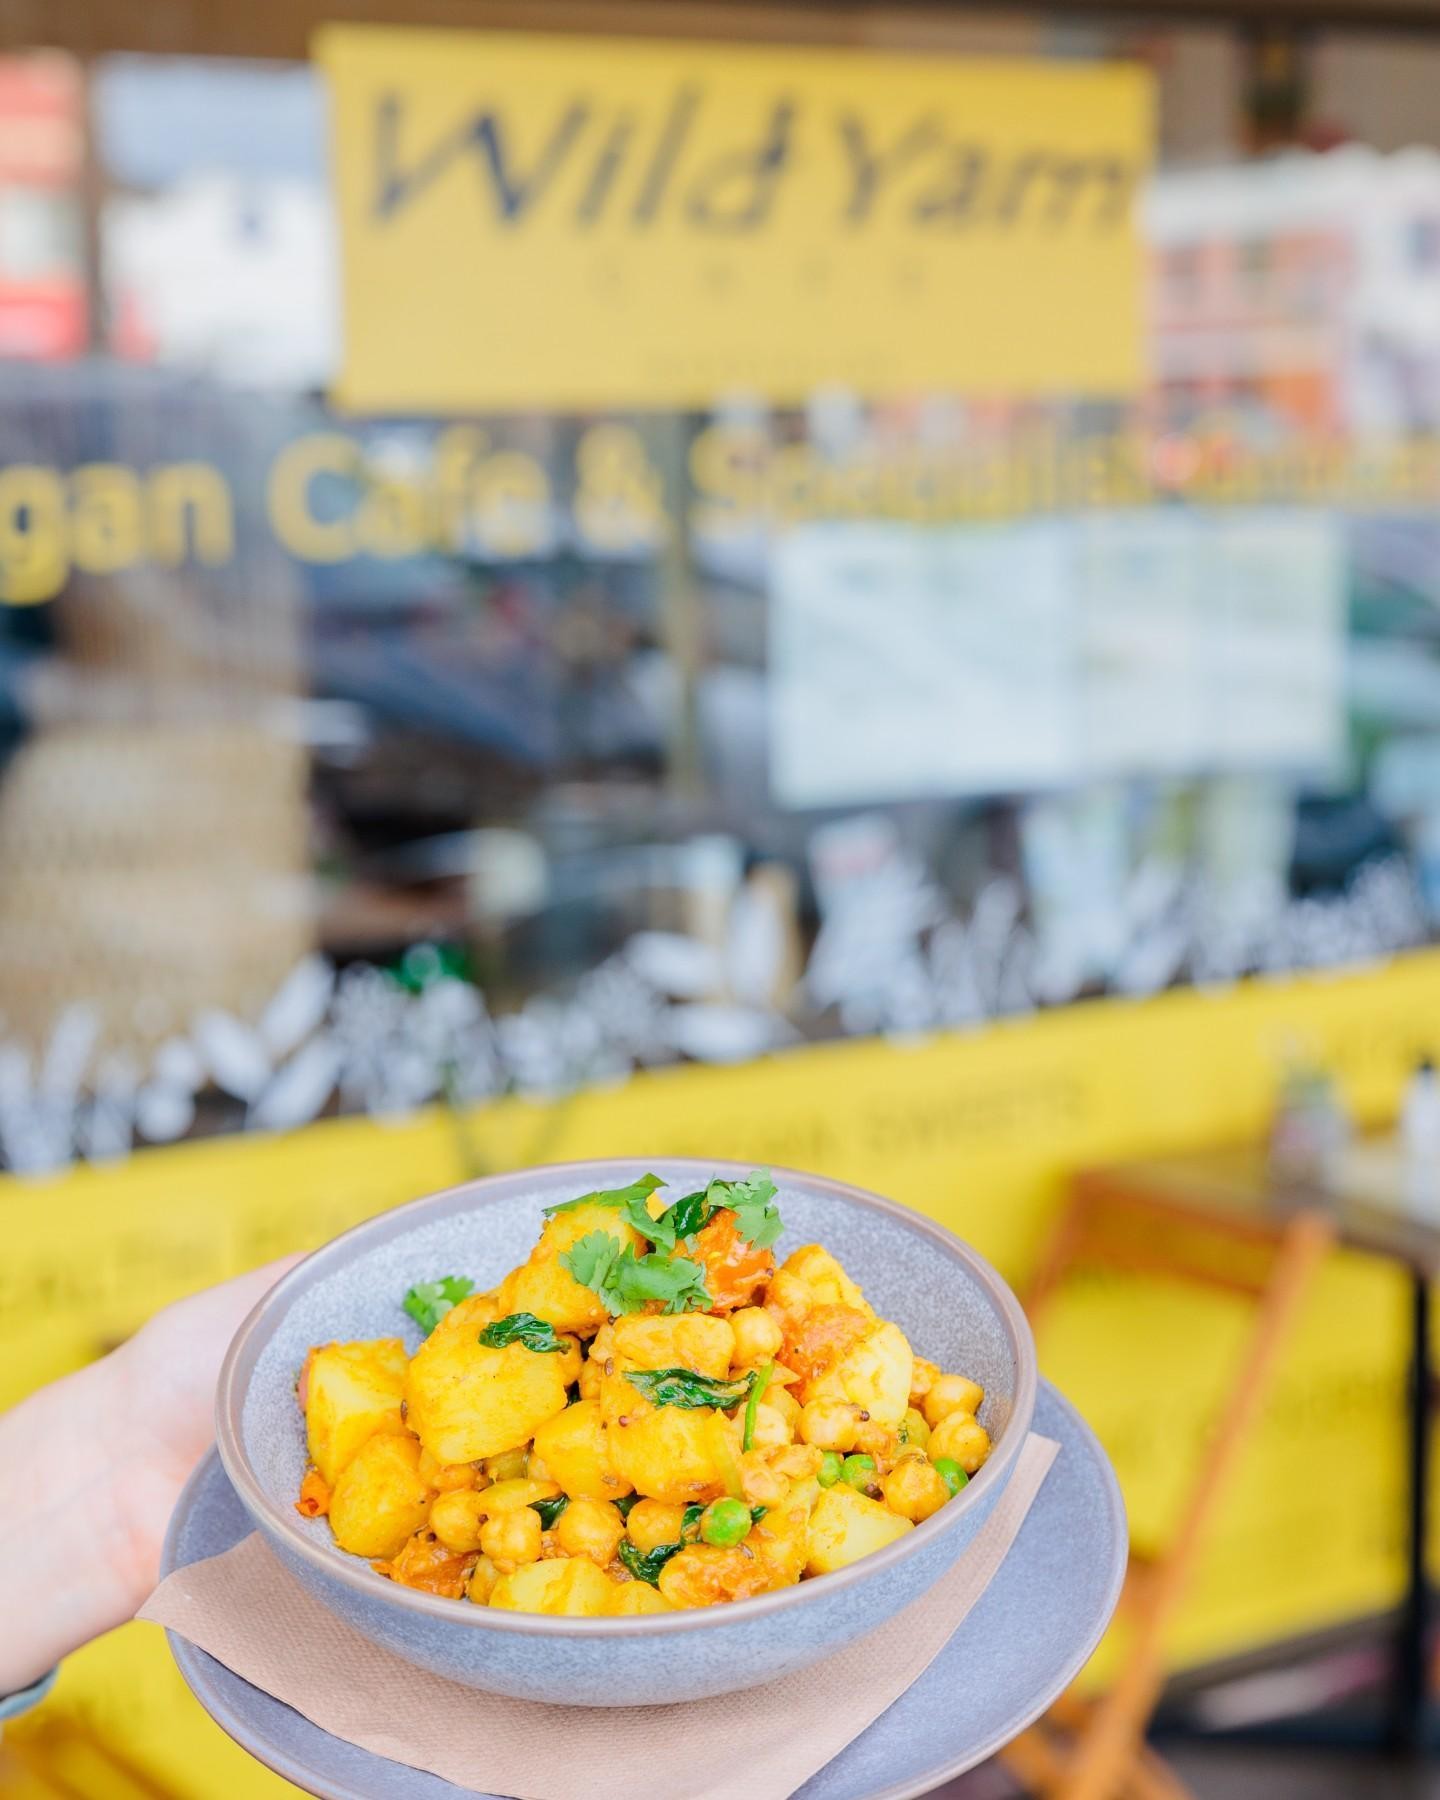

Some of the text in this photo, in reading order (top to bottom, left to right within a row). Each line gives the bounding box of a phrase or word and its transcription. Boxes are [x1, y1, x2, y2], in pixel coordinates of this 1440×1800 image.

[371, 78, 1136, 236] Wild Yam
[267, 422, 552, 564] Cafe
[574, 422, 672, 558] &
